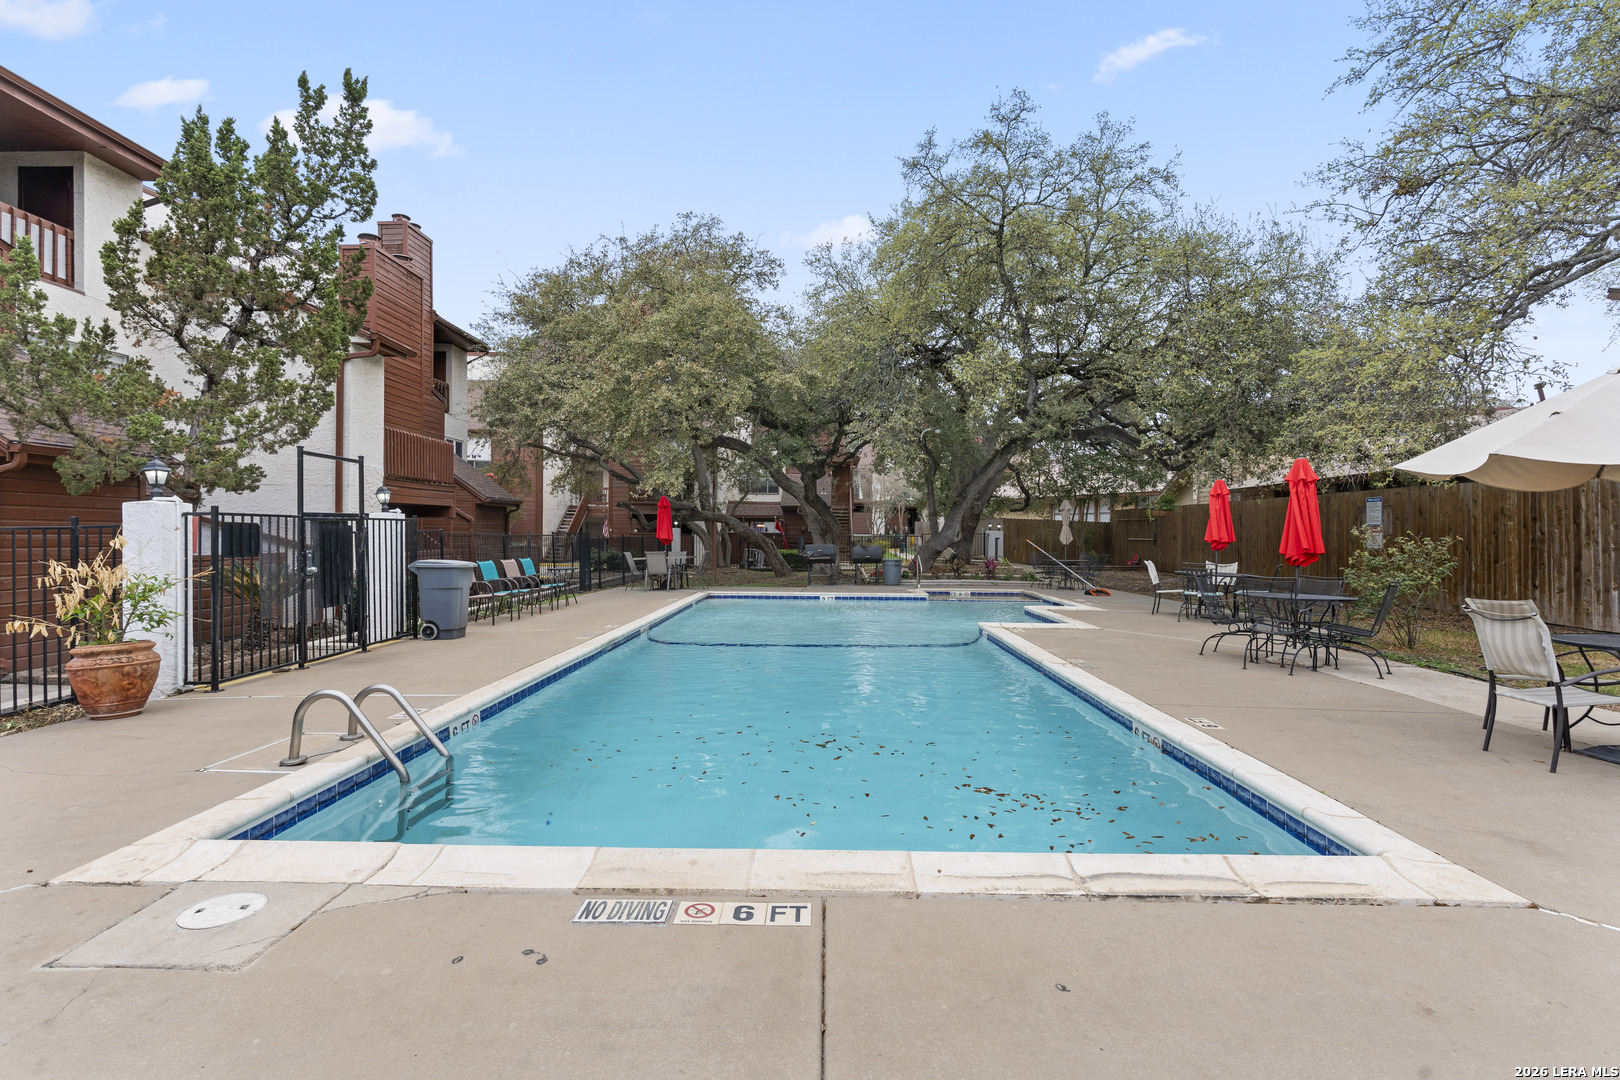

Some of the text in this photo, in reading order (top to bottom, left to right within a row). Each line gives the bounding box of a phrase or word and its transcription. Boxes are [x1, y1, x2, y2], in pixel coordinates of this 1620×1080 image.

[461, 719, 470, 732] FT
[578, 900, 668, 921] NO DIVING
[732, 905, 808, 923] 6 FT
